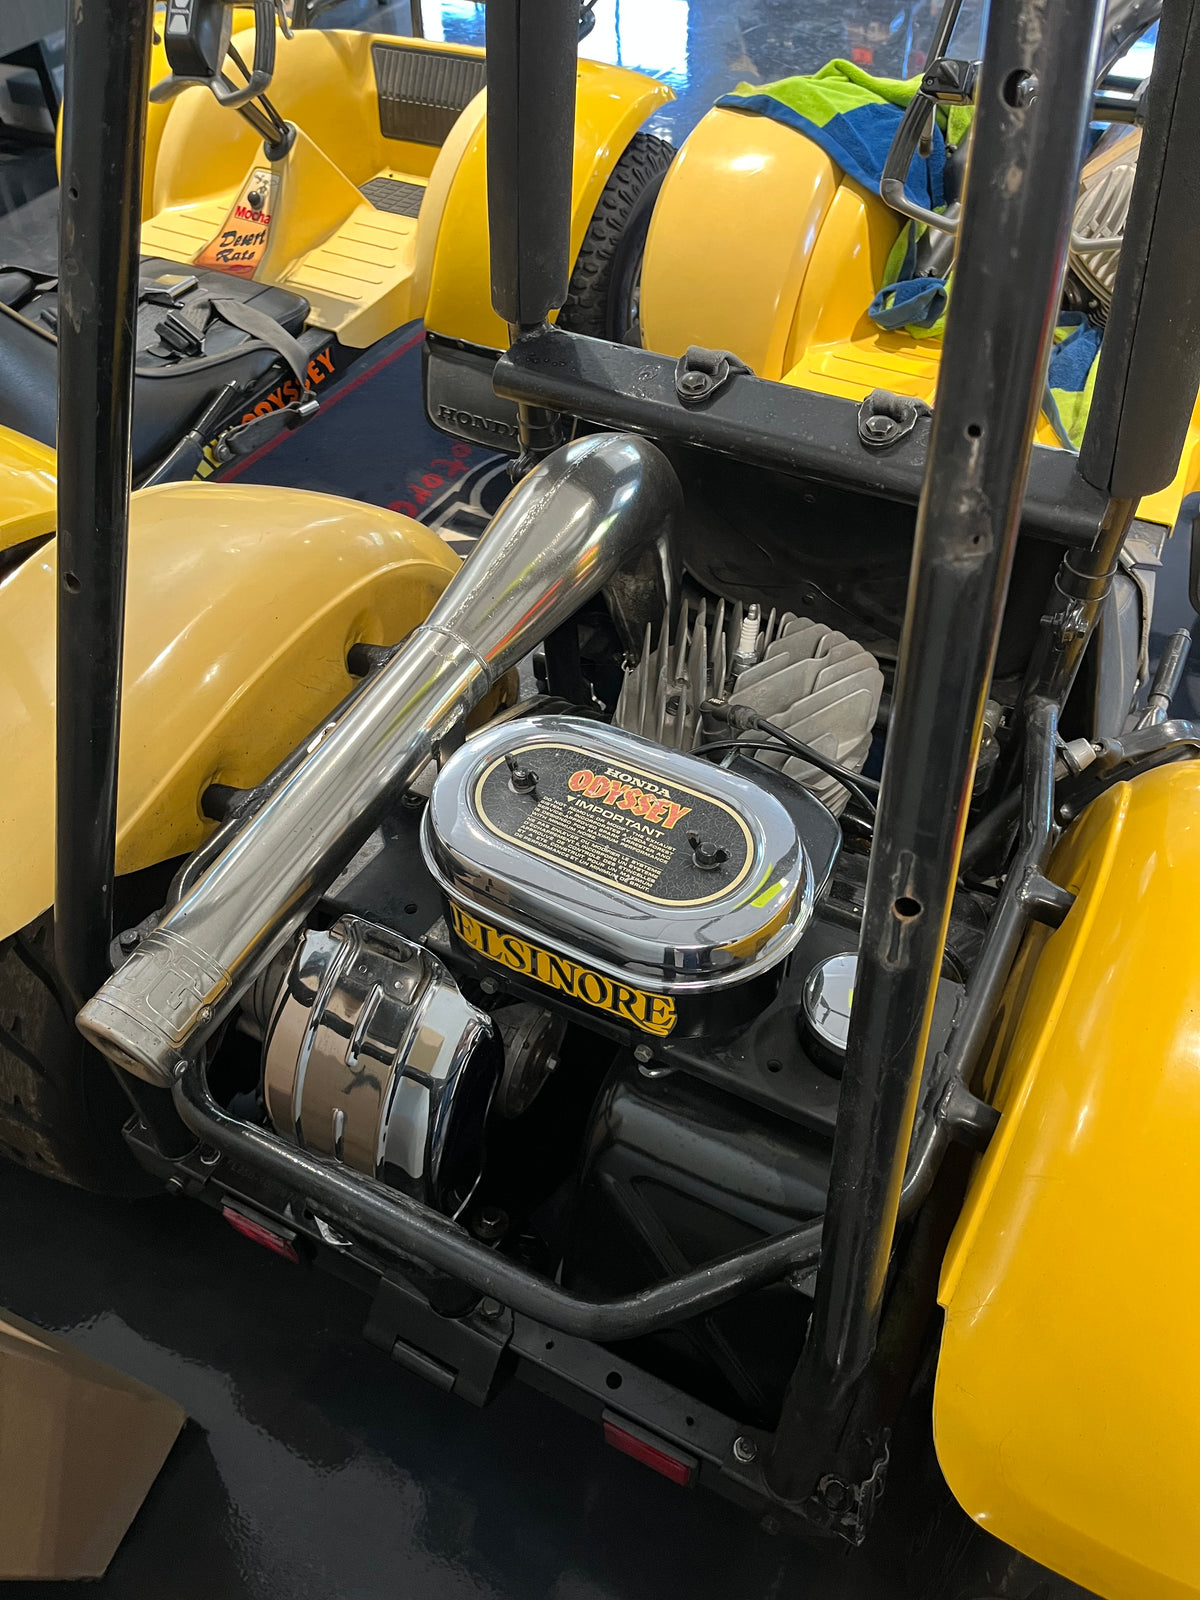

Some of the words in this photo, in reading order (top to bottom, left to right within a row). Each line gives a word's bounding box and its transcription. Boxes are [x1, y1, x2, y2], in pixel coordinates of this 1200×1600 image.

[234, 205, 272, 225] Mocha
[219, 229, 267, 249] Desert
[567, 769, 693, 830] ODYSSEY
[604, 768, 672, 799] HONDA
[542, 810, 571, 824] DESIGNED
[587, 829, 618, 843] MAXIMUM
[620, 842, 668, 864] PERFORMANCE
[548, 818, 576, 831] MINIMUM
[568, 806, 594, 818] REMOVE
[606, 821, 629, 832] MODIFY
[645, 837, 676, 851] EXHAUST
[574, 813, 620, 834] INCORPORATES
[648, 844, 673, 855] FOREST
[575, 799, 665, 839] IMPORTANT
[520, 825, 553, 840] APPROUVE
[567, 844, 600, 859] CONTROLE
[618, 865, 655, 882] ETINCELLES
[523, 836, 569, 857] PERFORMANCE
[551, 827, 578, 840] ENLEVER
[591, 844, 619, 857] MODIFIER
[631, 860, 661, 874] SYSTEME
[581, 844, 617, 861] INCORPORE
[628, 864, 658, 878] SYSTEME
[598, 828, 619, 838] SPARK
[621, 838, 654, 853] ARRESTER
[550, 842, 584, 858] CONSTRUIT
[586, 857, 605, 866] POUR
[619, 871, 652, 886] MAXIMUM
[455, 909, 675, 1036] ELSINORE
